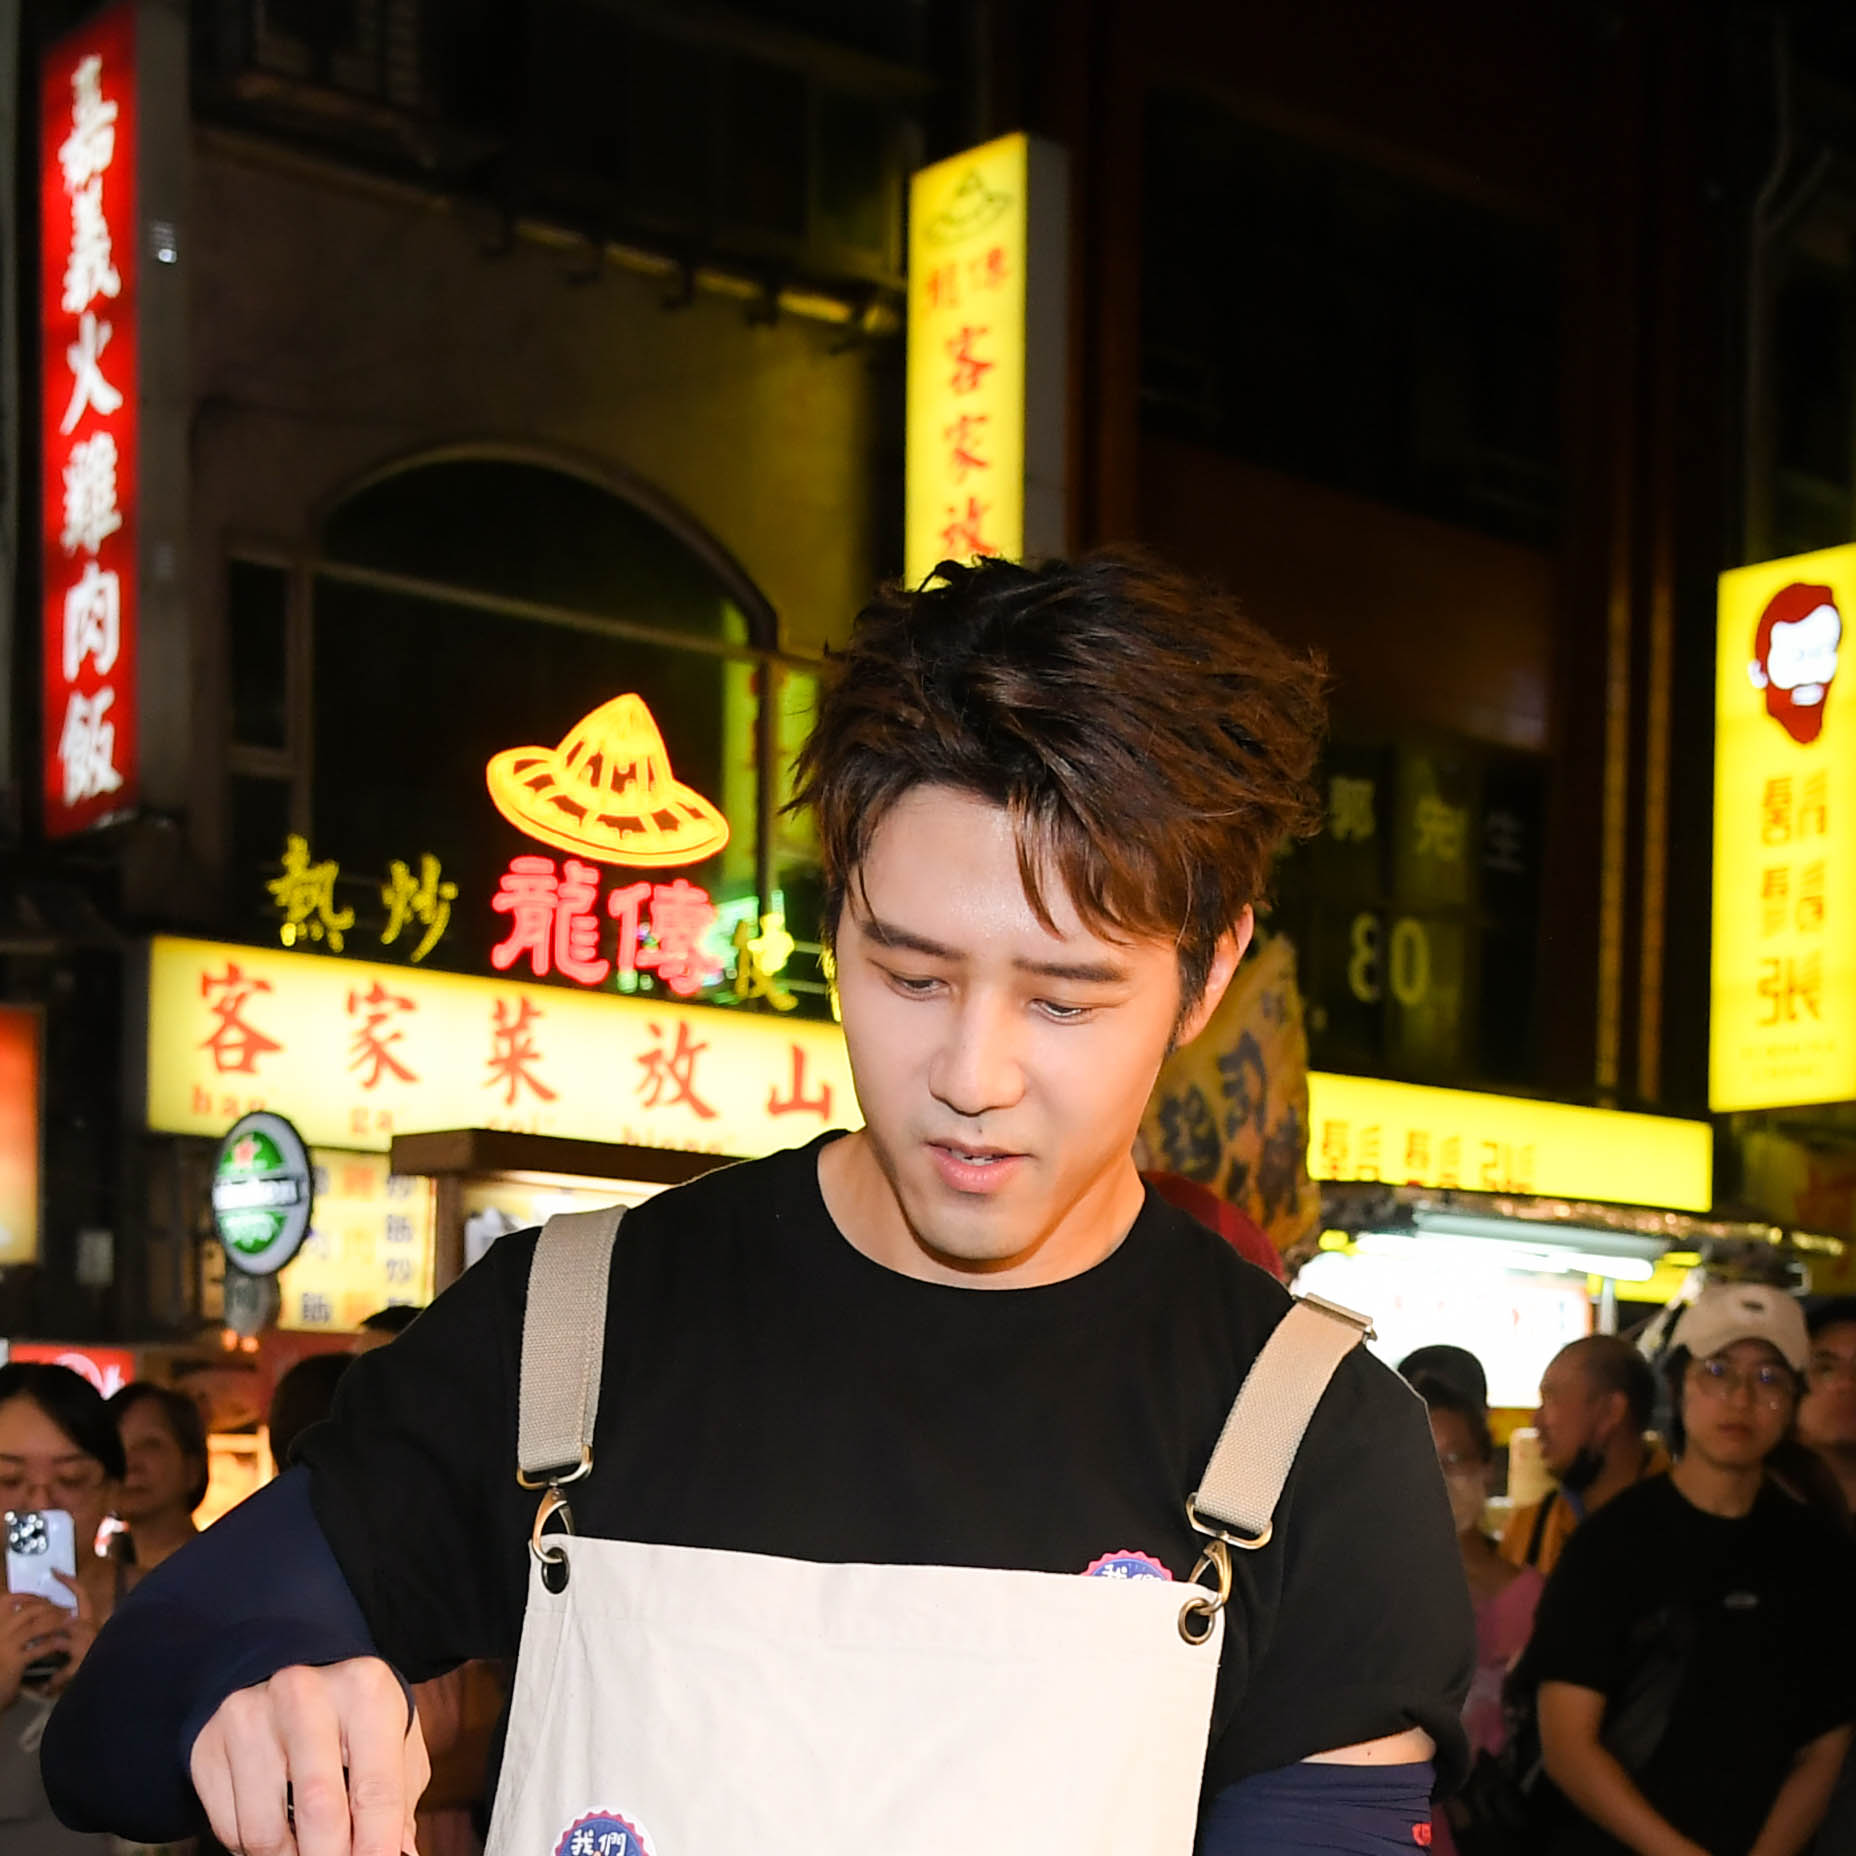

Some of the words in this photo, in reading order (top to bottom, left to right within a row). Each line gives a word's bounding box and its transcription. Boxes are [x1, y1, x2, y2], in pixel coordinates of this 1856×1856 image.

[58, 53, 122, 806] 嘉義火雞肉飯
[199, 960, 833, 1122] 客家菜放山
